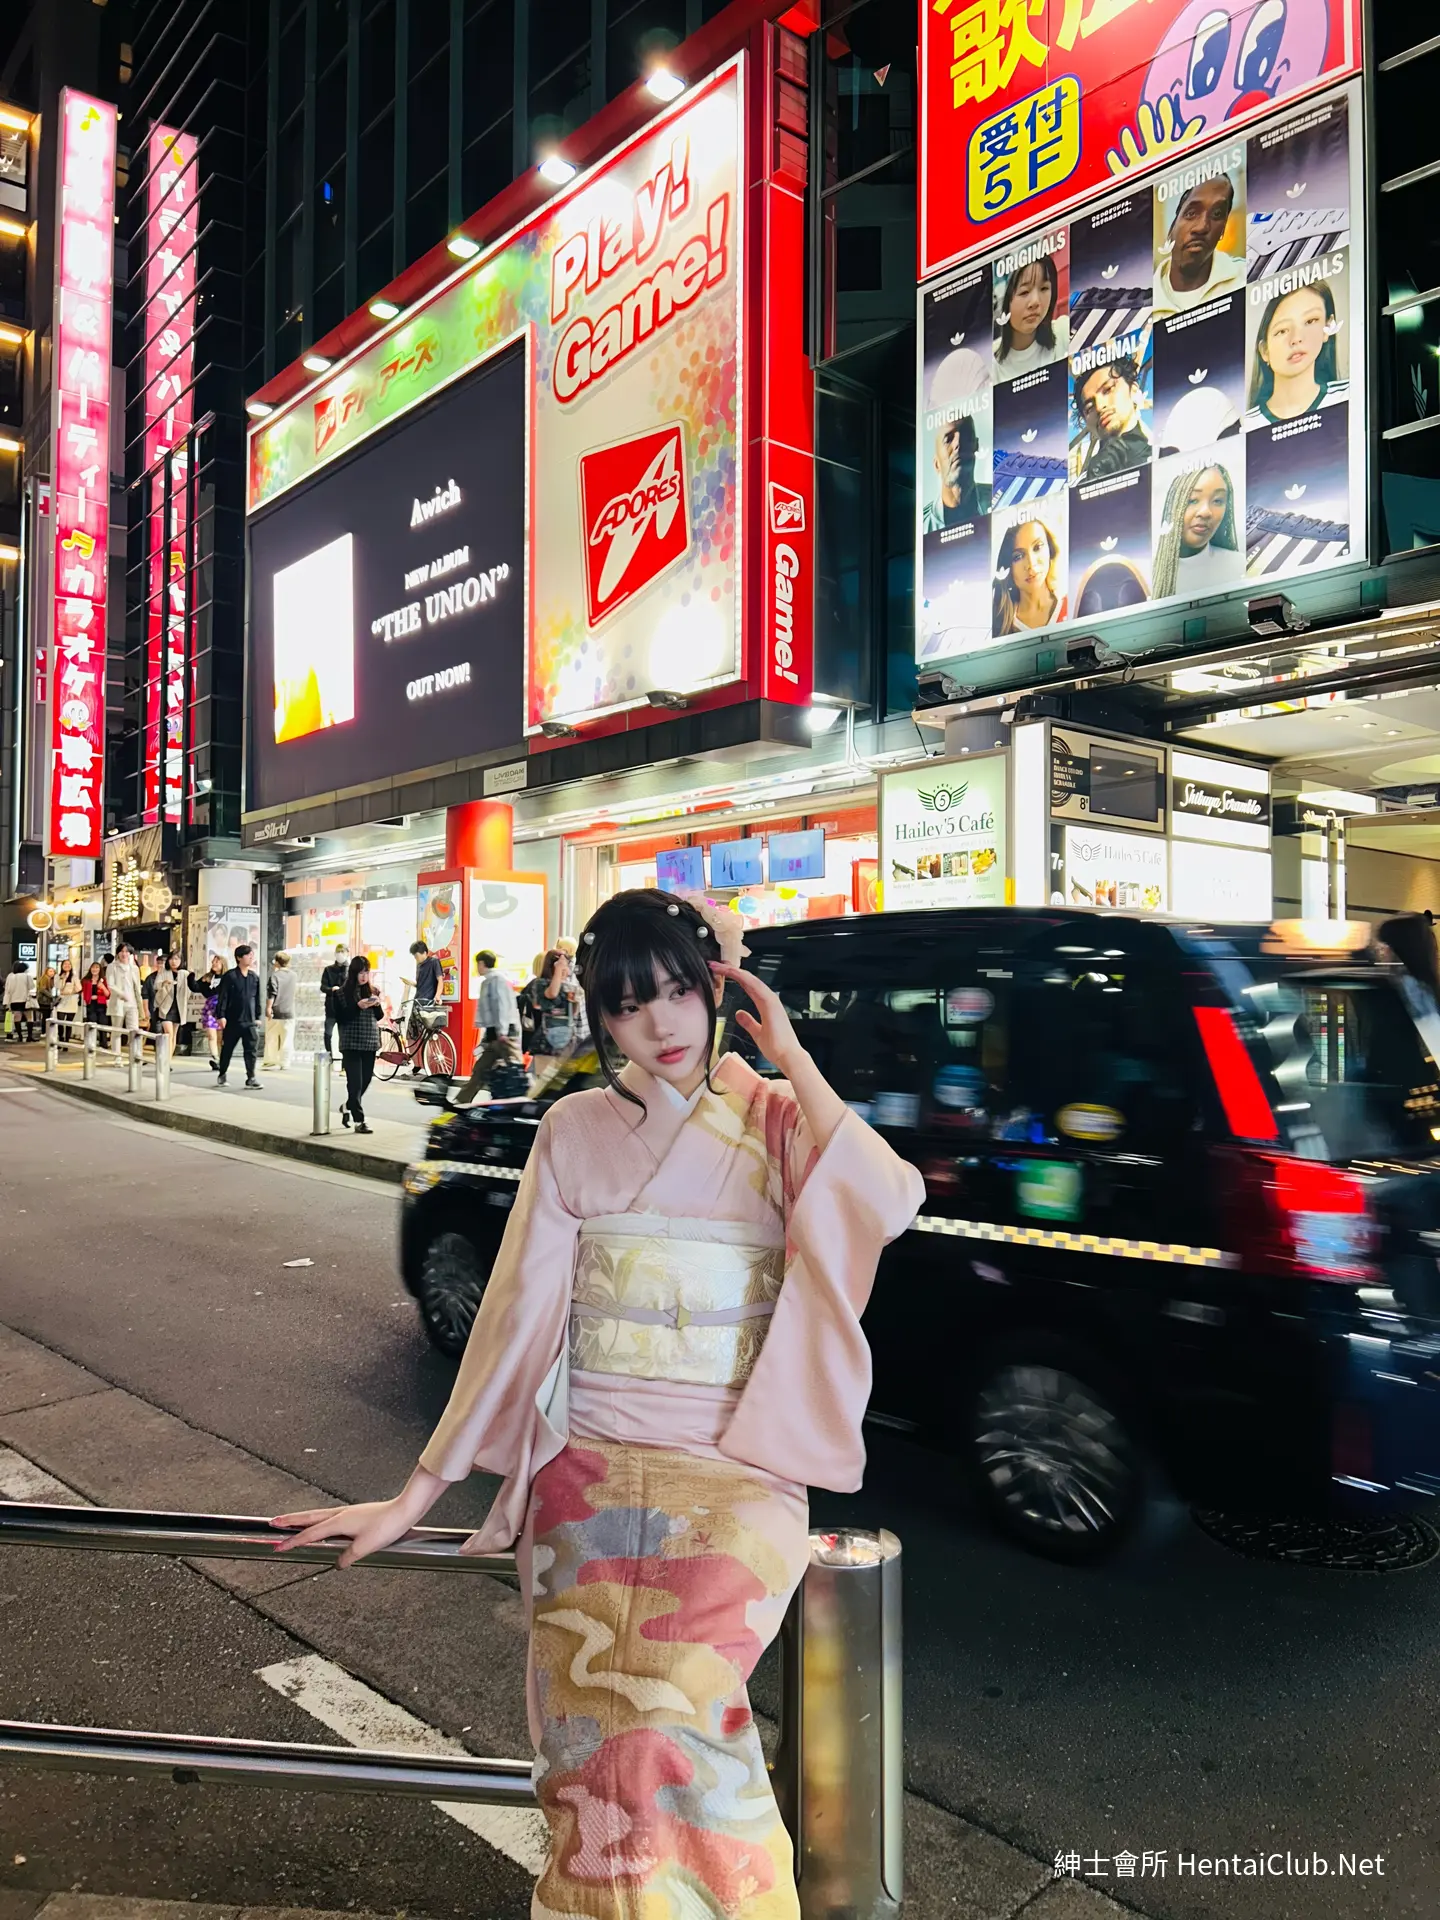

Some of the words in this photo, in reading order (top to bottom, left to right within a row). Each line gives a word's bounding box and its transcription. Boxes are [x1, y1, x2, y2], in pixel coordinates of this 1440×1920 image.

[979, 85, 1068, 171] 受付
[1157, 148, 1242, 202] ORIGINALS
[551, 136, 690, 325] Play!
[996, 231, 1066, 278] ORIGINALS
[553, 192, 730, 404] Game!
[1250, 252, 1344, 305] ORIGINALS
[927, 392, 989, 431] ORIGINALS
[410, 479, 462, 528] Awich
[592, 472, 679, 543] ADORES
[404, 564, 430, 590] NEW
[430, 545, 469, 579] ALBUM
[774, 543, 800, 684] Game!
[406, 674, 435, 700] OUT
[435, 662, 471, 692] NOW!
[959, 812, 994, 833] Café
[1180, 783, 1221, 815] Shibuya
[1217, 790, 1261, 815] Scramble
[1051, 852, 1064, 870] 7F
